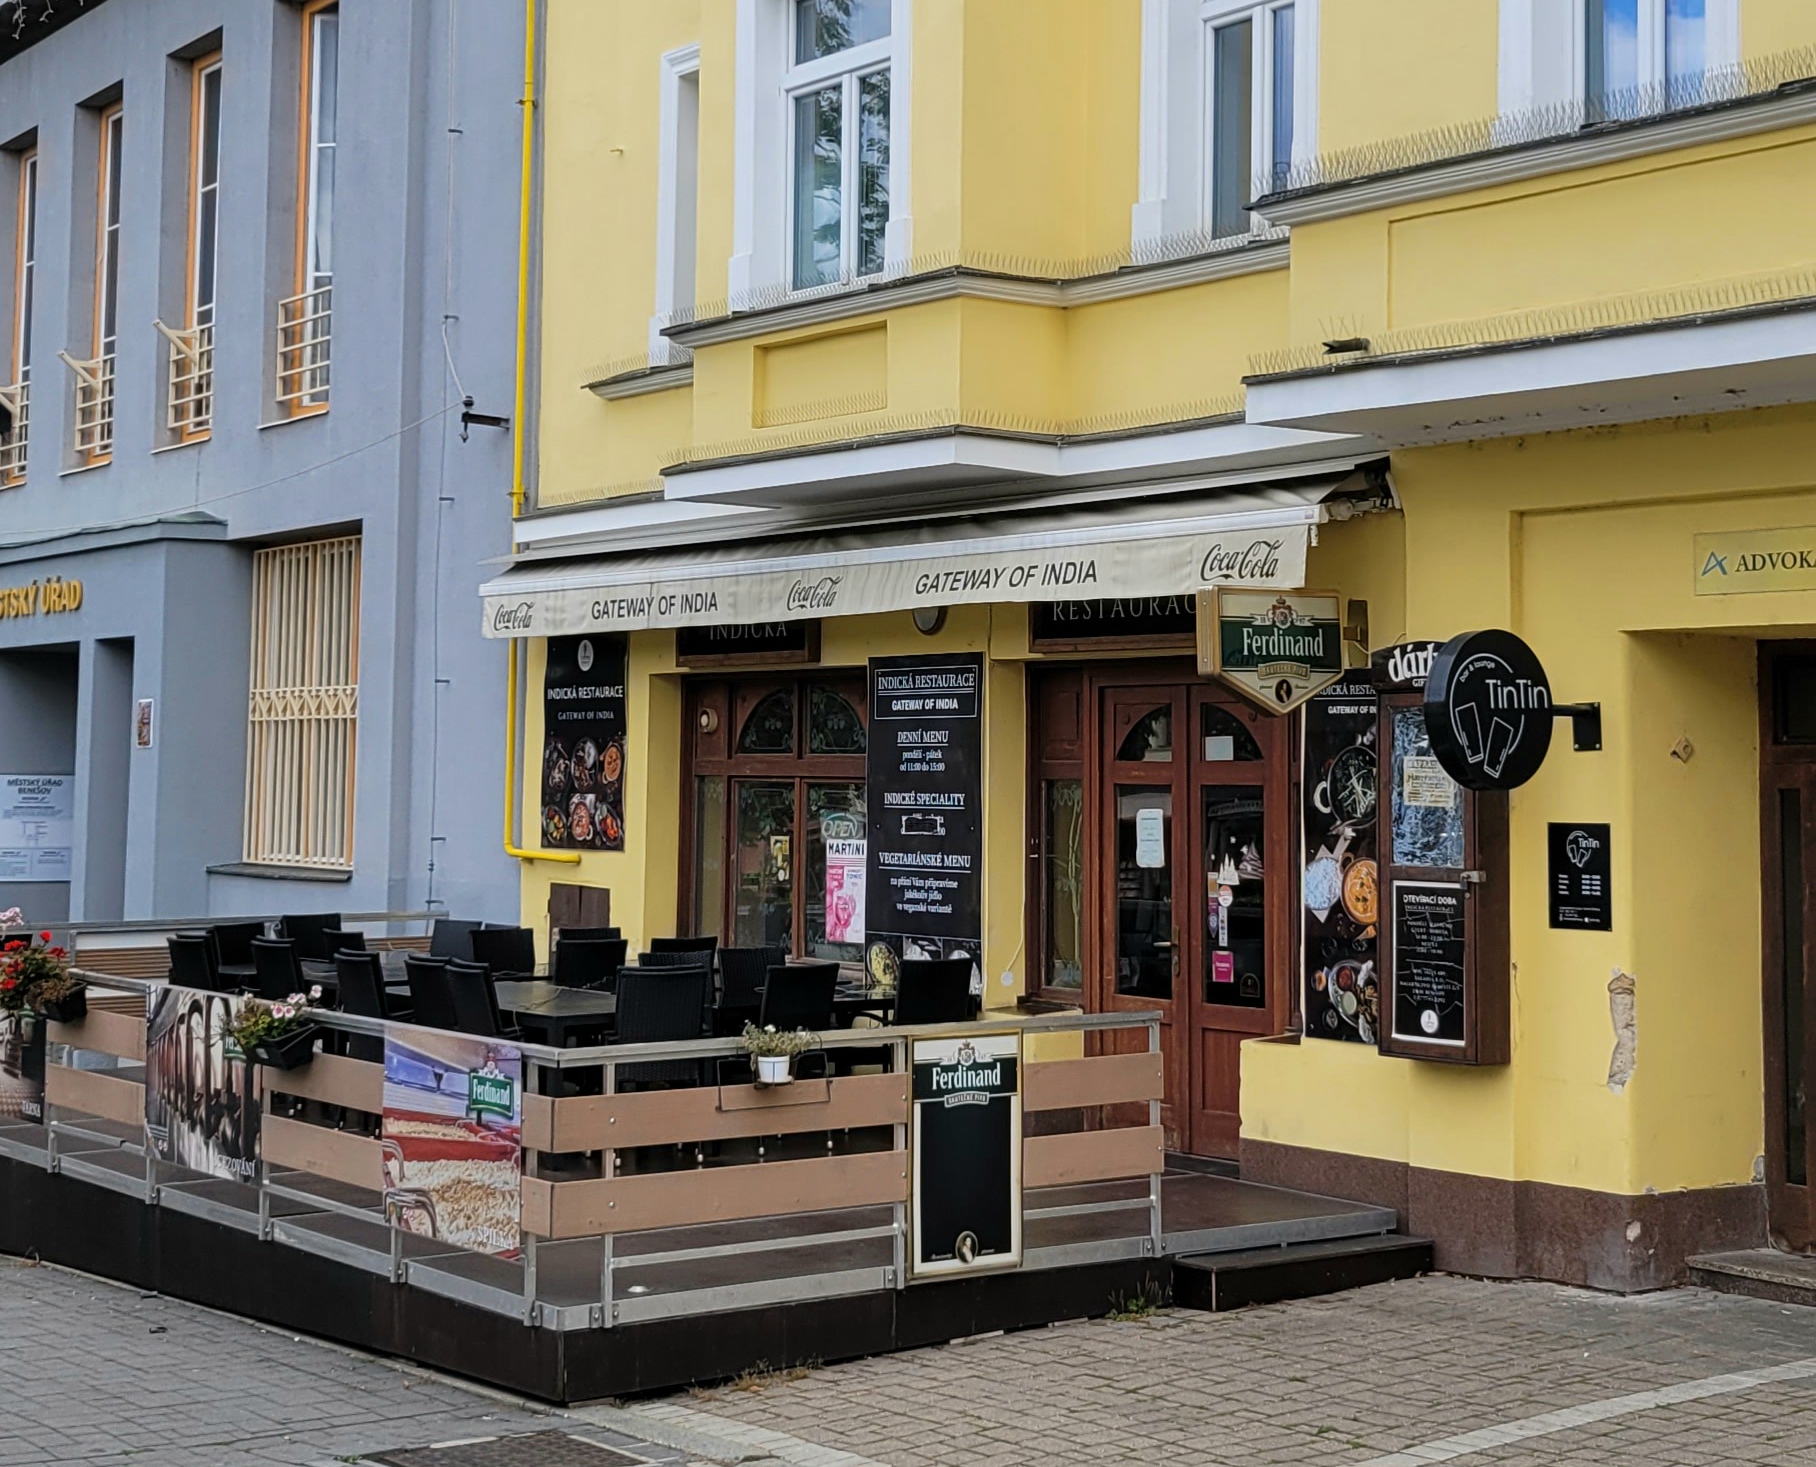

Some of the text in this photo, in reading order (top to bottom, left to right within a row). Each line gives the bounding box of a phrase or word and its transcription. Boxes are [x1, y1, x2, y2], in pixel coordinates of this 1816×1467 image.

[915, 560, 1097, 595] GATEWAY OF INDIA
[40, 575, 83, 616] ÚŘAD
[591, 591, 718, 621] GATEWAY OF INDIA
[1053, 594, 1196, 621] RESTAURAC
[1242, 627, 1324, 657] Ferdinand
[1459, 669, 1469, 683] bar
[1473, 660, 1496, 669] lounge
[878, 673, 974, 690] INDICKÁ RESTAURACE
[1317, 682, 1348, 695] DICKÁ
[1349, 684, 1376, 695] RESTA
[1412, 678, 1428, 687] GIF
[547, 685, 623, 700] INDICKÁ RESTAURACE
[1485, 679, 1548, 709] TinTin
[891, 698, 958, 711] GATEWAY OF INDIA
[1359, 705, 1369, 714] OF
[1369, 705, 1377, 714] IN
[557, 710, 614, 721] GATEWAY OF INDIA
[897, 729, 949, 743] DENNÍ MENU
[926, 748, 943, 762] pátek
[900, 761, 907, 772] od
[922, 761, 930, 772] do
[884, 790, 965, 806] INDICKÉ SPECIALITY
[822, 820, 856, 837] OPEN
[828, 842, 865, 856] MARTINI
[1578, 837, 1600, 849] TinTin
[879, 851, 971, 868] VEGETARIÁNSKÉ MENU
[1437, 896, 1457, 905] DOBA
[932, 1061, 1001, 1091] Ferdinand
[472, 1078, 510, 1106] Ferdinand
